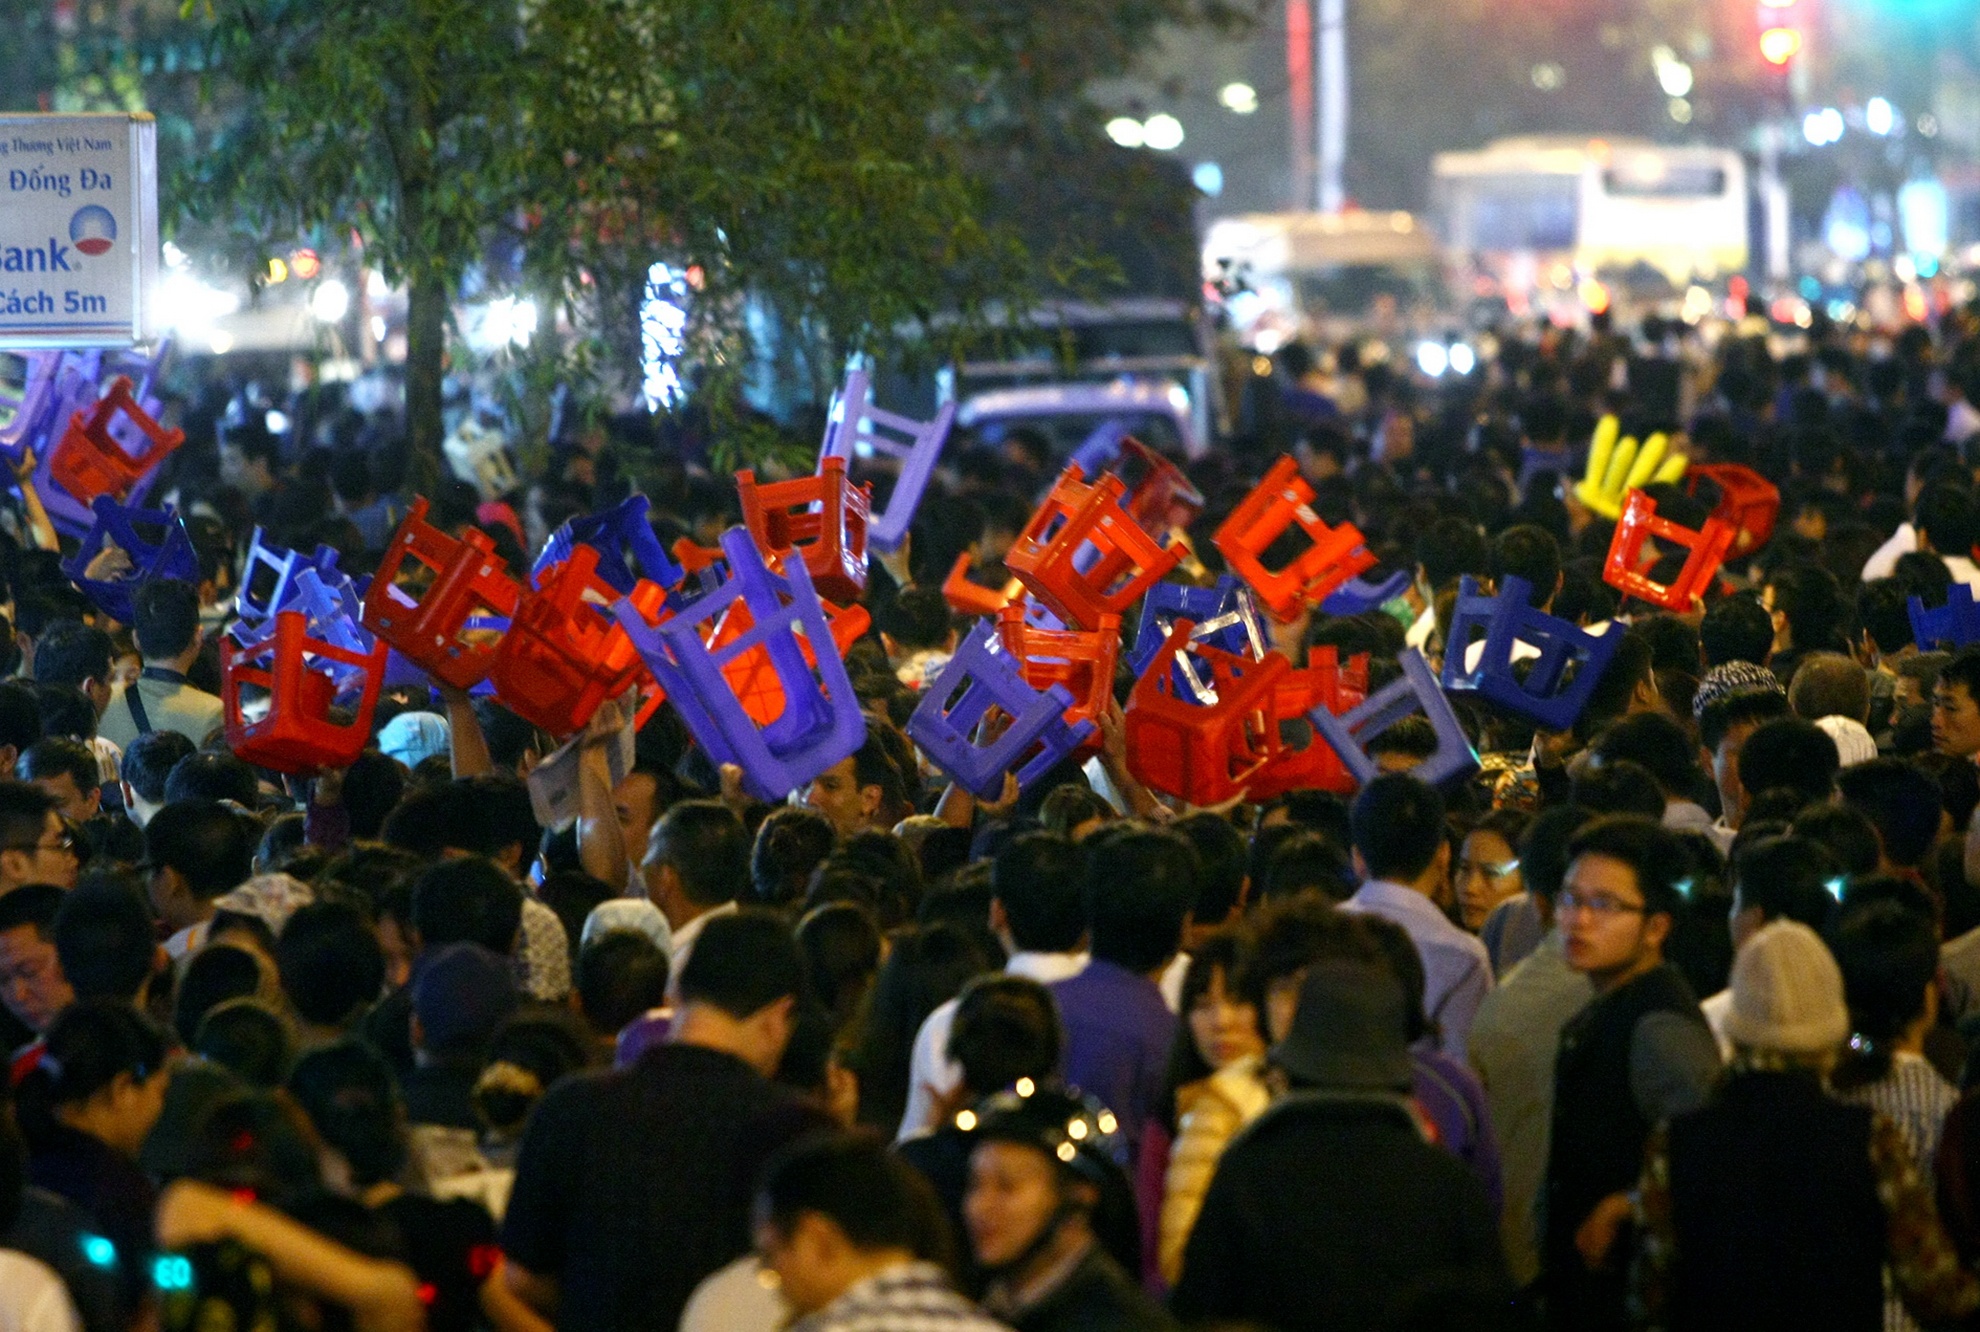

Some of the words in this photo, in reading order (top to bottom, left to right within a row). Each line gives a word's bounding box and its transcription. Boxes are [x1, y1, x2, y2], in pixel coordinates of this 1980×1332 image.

[84, 137, 112, 151] Nam
[10, 164, 71, 197] Đống
[80, 168, 112, 191] Đa
[0, 236, 71, 272] ank
[64, 290, 107, 314] 5m
